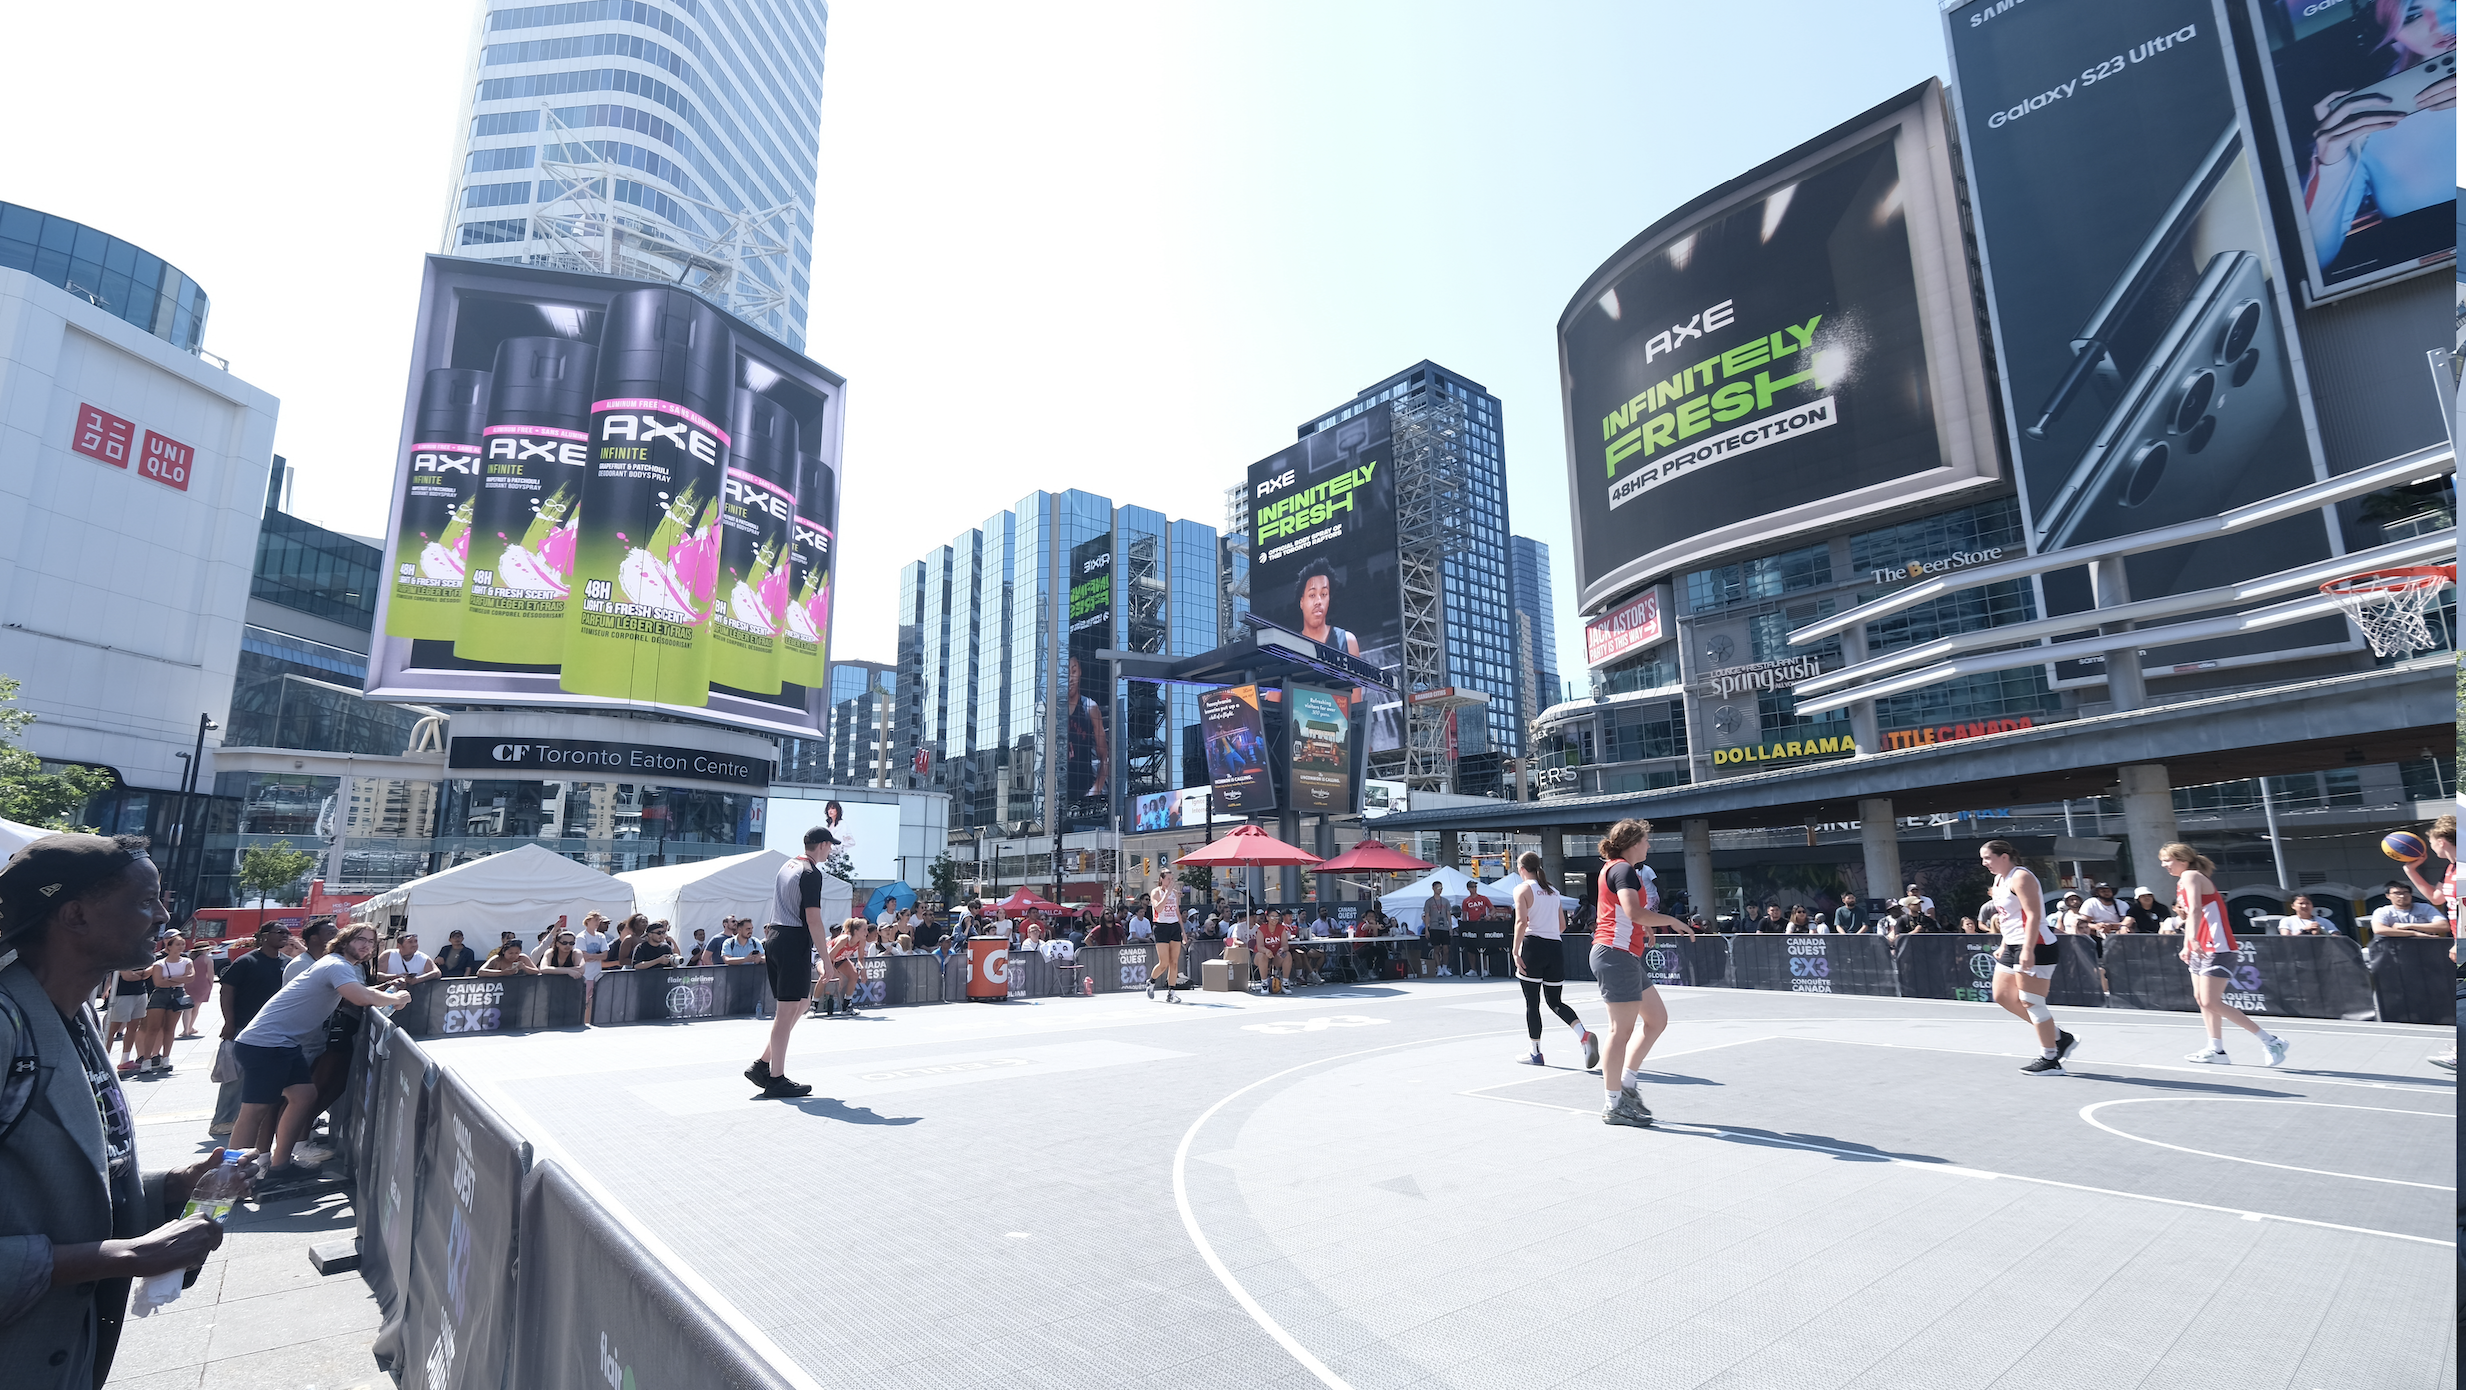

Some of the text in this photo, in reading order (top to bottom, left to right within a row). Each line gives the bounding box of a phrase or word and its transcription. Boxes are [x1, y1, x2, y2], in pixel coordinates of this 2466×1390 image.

[1987, 24, 2197, 129] Galaxy S23 Ultra
[1645, 298, 1735, 365] AXE
[1602, 313, 1823, 442] INFINITELY
[639, 400, 659, 409] FREE
[669, 405, 690, 418] SANS
[1605, 350, 1841, 479] FRESH
[541, 428, 559, 436] SANS
[602, 414, 717, 466] AXE
[150, 437, 186, 464] UNI
[489, 438, 587, 467] AXE
[600, 447, 648, 461] INFINITE
[1612, 406, 1827, 501] 48HR PROTECTION
[146, 457, 185, 484] QLO
[629, 470, 672, 483] BODYSPRAY
[632, 464, 670, 476] PATCHOULI
[1257, 469, 1295, 498] AXE
[1258, 460, 1377, 526] INFINITELY
[726, 479, 788, 521] AXE
[1258, 491, 1353, 546] FRESH
[792, 525, 828, 553] XE
[1268, 524, 1343, 556] OFFICIAL BODY SPRAY OF
[1283, 541, 1311, 558] TORONTO
[1312, 530, 1343, 546] RAPTORS
[416, 577, 440, 587] FRESH
[472, 569, 494, 585] 48H
[1870, 566, 1907, 585] The
[494, 587, 555, 600] FRESH SCENT
[584, 579, 612, 600] 48H
[491, 609, 520, 618] CORPOREL
[495, 597, 565, 611] LÉGER ET FRAIS
[605, 601, 613, 614] &
[614, 602, 652, 619] FRESH
[653, 607, 685, 625] SCENT
[581, 612, 615, 629] PARFUM
[616, 614, 653, 633] LÉGER
[655, 621, 669, 636] ET
[669, 623, 693, 640] FRAIS
[728, 618, 749, 633] FRESH
[1589, 597, 1656, 649] JACK ASTOR'S
[611, 631, 649, 643] CORPOREL
[1590, 625, 1643, 662] PARTY IS THIS WAY
[1710, 656, 1800, 678] LOUNGE RESTAURANT
[1937, 717, 2034, 743] CANADA
[491, 743, 749, 778] CF Toronto Eaton Centre
[1714, 734, 1856, 765] DOLLARAMA
[1264, 936, 1280, 944] CAN
[1786, 938, 1826, 946] CANADA
[1787, 946, 1827, 956] QUEST
[1119, 948, 1146, 956] CANADA
[1119, 955, 1147, 964] QUEST
[983, 948, 1009, 984] G
[1396, 962, 1405, 977] 4
[446, 982, 504, 994] CANADA
[1791, 978, 1831, 986] CONQUÊTE
[1792, 985, 1832, 993] CANADA
[1972, 981, 1992, 989] GLO
[445, 992, 504, 1007] QUEST
[1955, 988, 1990, 1003] FES
[454, 1147, 477, 1214] QUEST
[600, 1330, 623, 1390] flair
